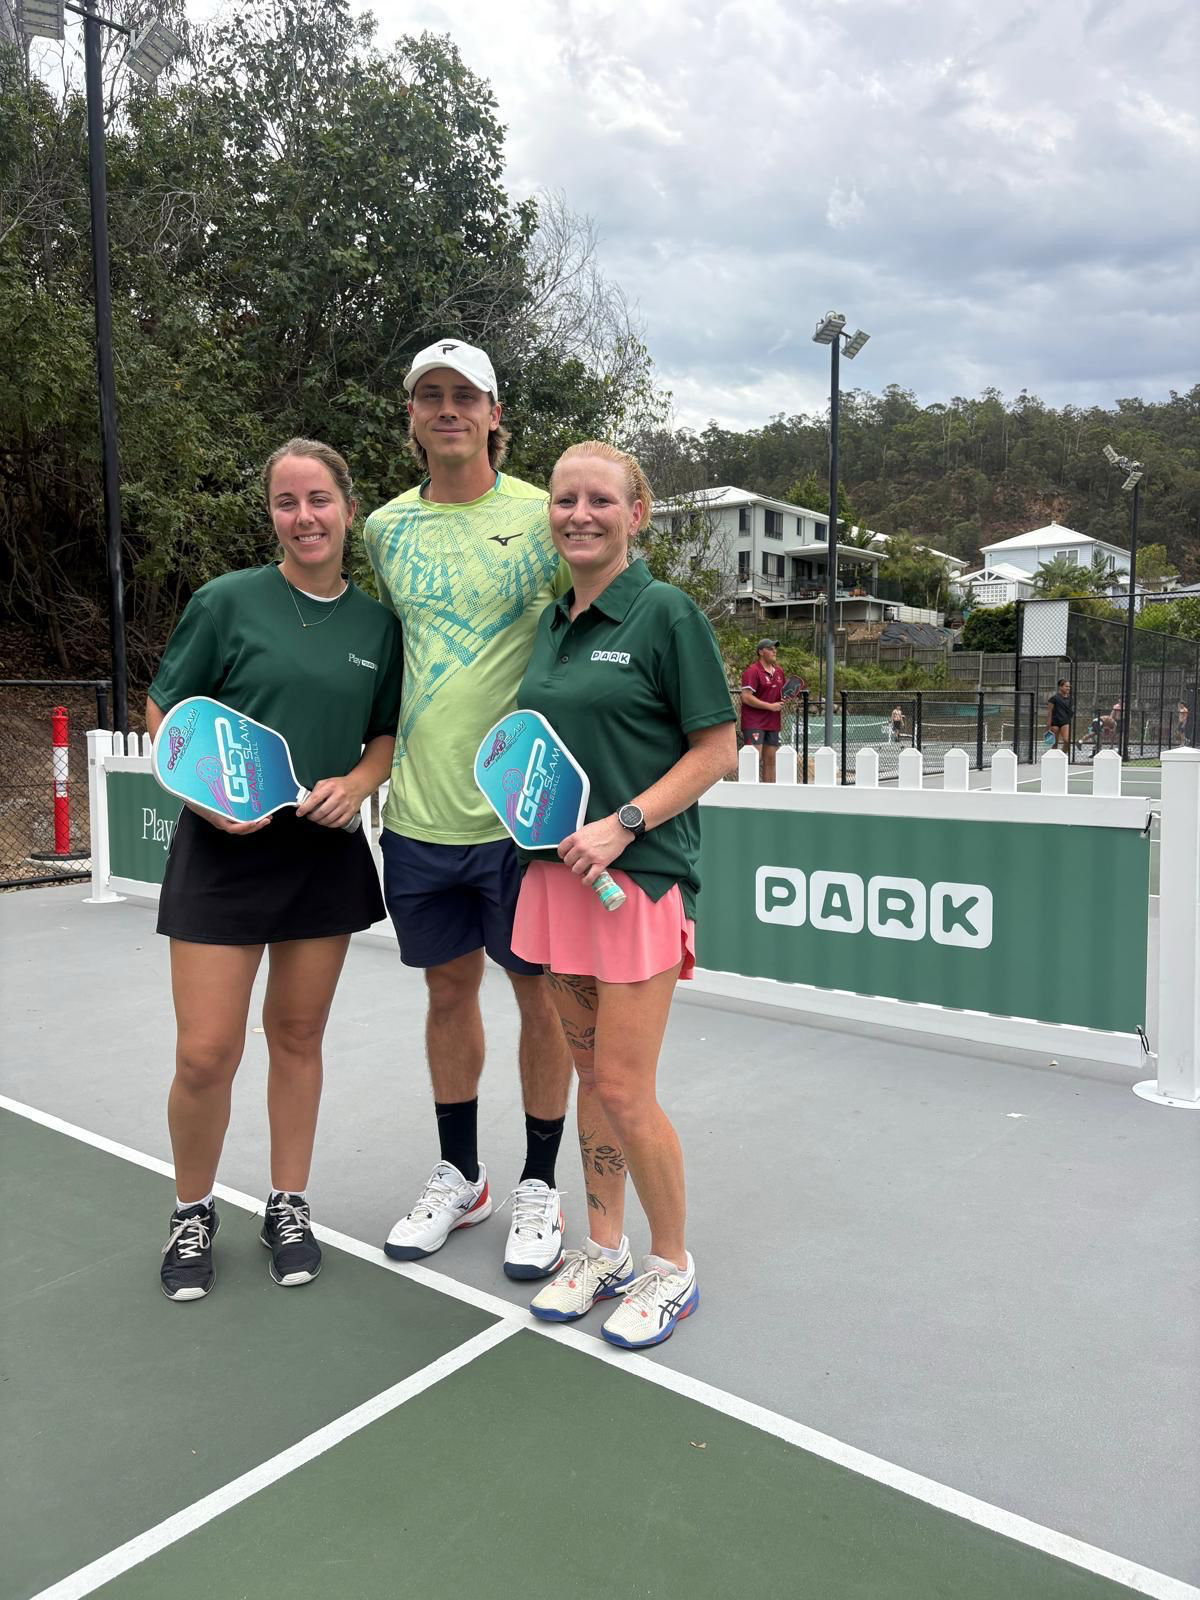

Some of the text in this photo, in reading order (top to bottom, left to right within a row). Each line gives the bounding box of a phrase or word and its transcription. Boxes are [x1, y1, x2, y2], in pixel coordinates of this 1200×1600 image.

[591, 651, 630, 664] PARK
[214, 716, 250, 804] GSP
[238, 719, 262, 813] GRAND SLAM
[250, 741, 265, 791] PICKLEBALL
[515, 737, 548, 828] GSP
[543, 747, 561, 790] SLAM
[141, 807, 174, 851] Play
[760, 871, 985, 942] PARK
